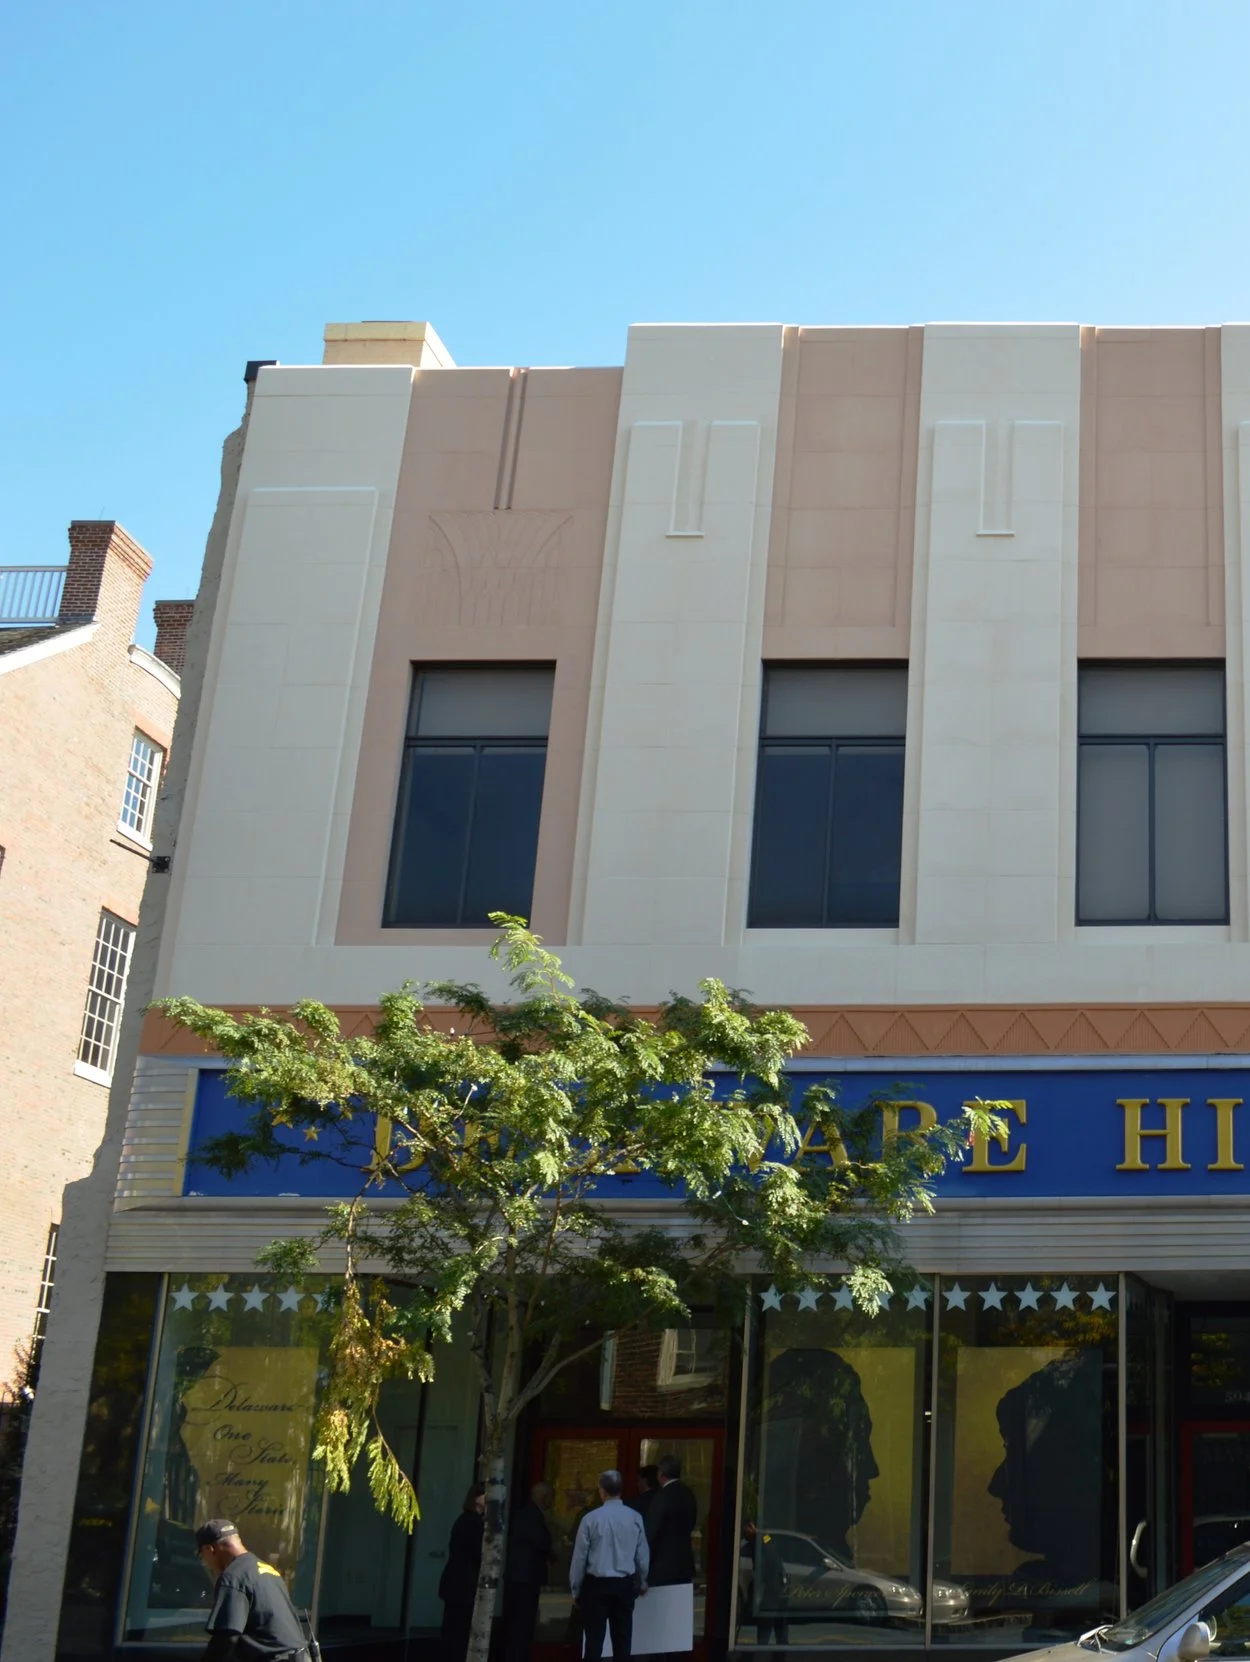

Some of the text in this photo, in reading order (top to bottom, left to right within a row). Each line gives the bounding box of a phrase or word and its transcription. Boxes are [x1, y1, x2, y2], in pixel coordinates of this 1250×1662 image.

[360, 1099, 1027, 1174] DARE
[1224, 1390, 1250, 1404] 504
[213, 1424, 252, 1442] One
[206, 1472, 269, 1496] Many
[218, 1488, 295, 1518] Stori
